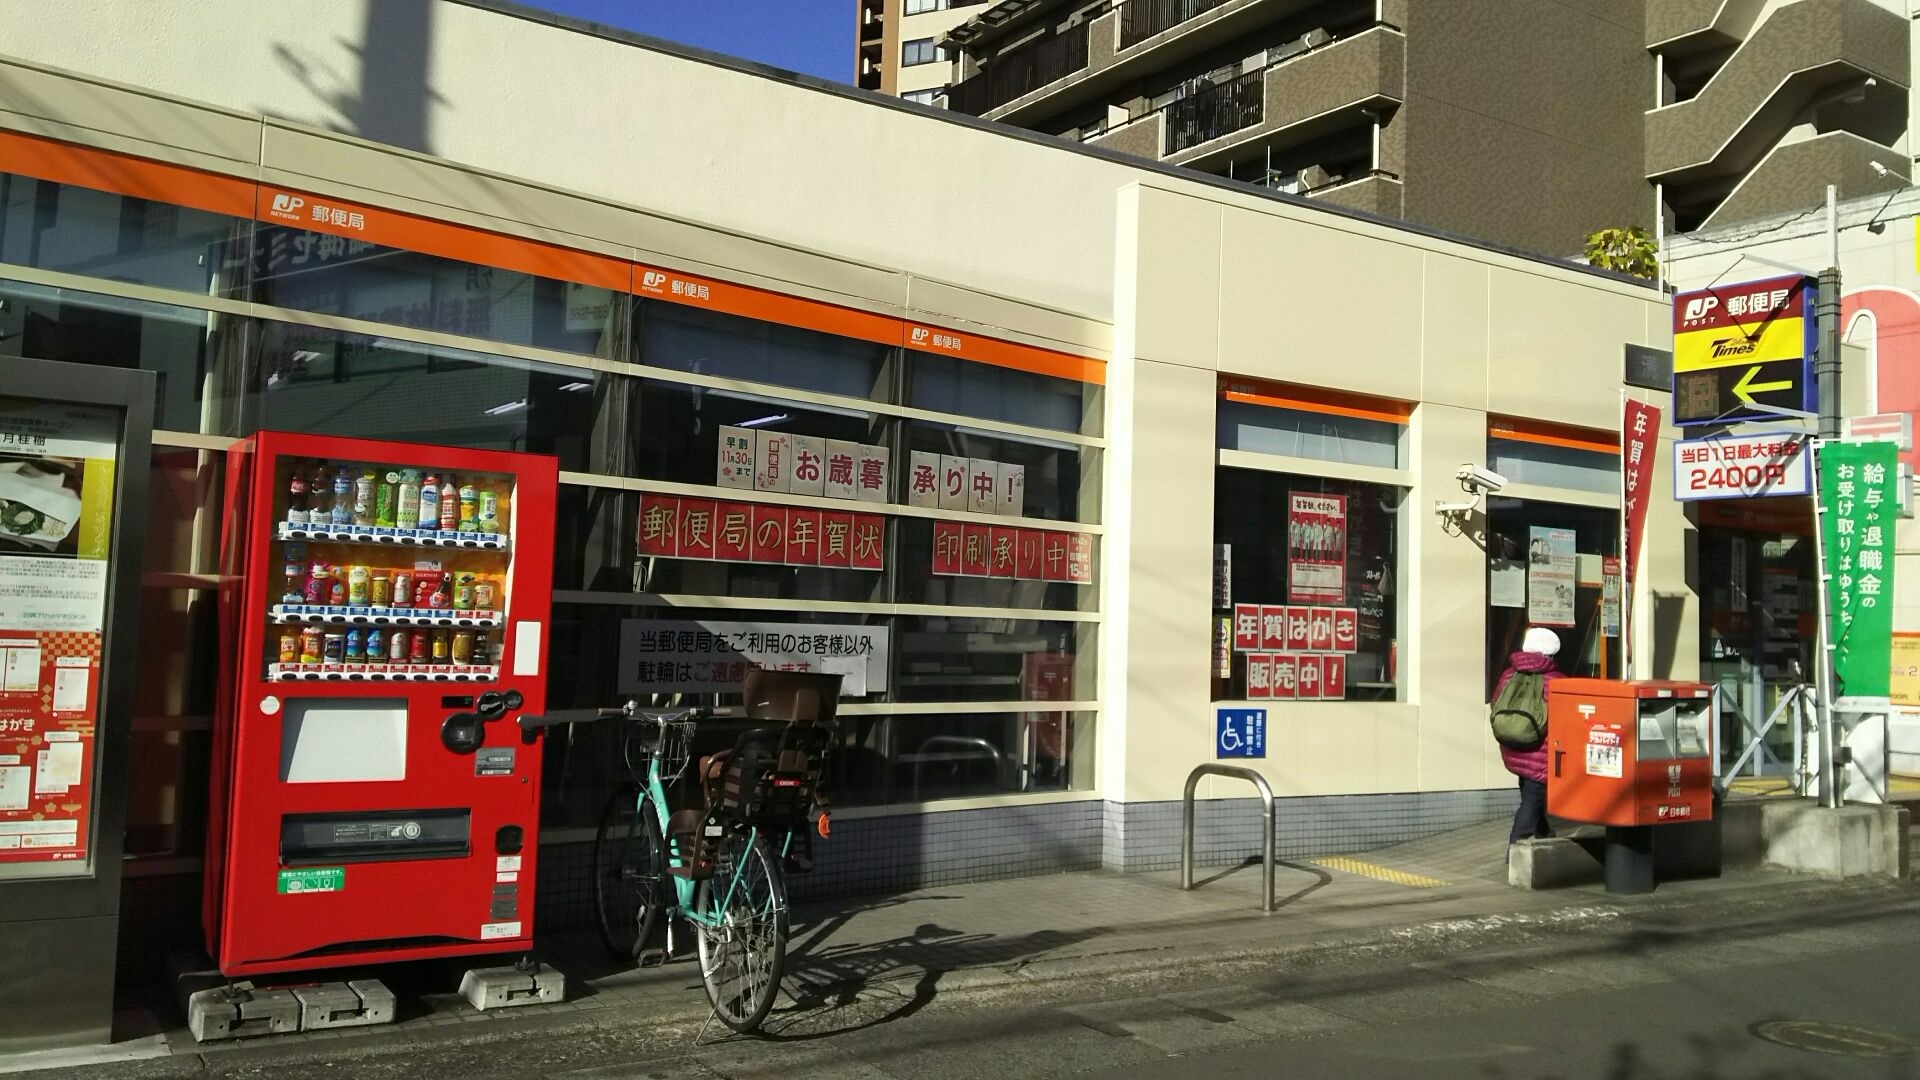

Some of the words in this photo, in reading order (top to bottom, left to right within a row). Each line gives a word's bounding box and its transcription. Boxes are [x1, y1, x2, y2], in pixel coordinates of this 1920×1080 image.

[270, 210, 300, 221] NETWORK
[312, 205, 365, 231] 郵便局
[671, 279, 709, 301] 郵便局
[1727, 288, 1790, 317] 郵便局
[1683, 316, 1716, 328] POST
[932, 333, 962, 351] 郵便局
[1710, 337, 1756, 359] Times
[726, 436, 748, 450] 早割
[721, 450, 752, 466] 11月30日
[767, 439, 780, 487] 郵便局の
[795, 450, 885, 490] お歳暮
[736, 466, 751, 476] まで
[1690, 463, 1786, 491] 2400円
[642, 505, 880, 560] 郵便局の年賀状
[936, 530, 1066, 573] 印刷承り中
[1858, 462, 1886, 608] 給与や退職金の
[1237, 612, 1355, 642] 年賀はがき
[639, 630, 874, 655] 当郵便局をご利用のお客様以外
